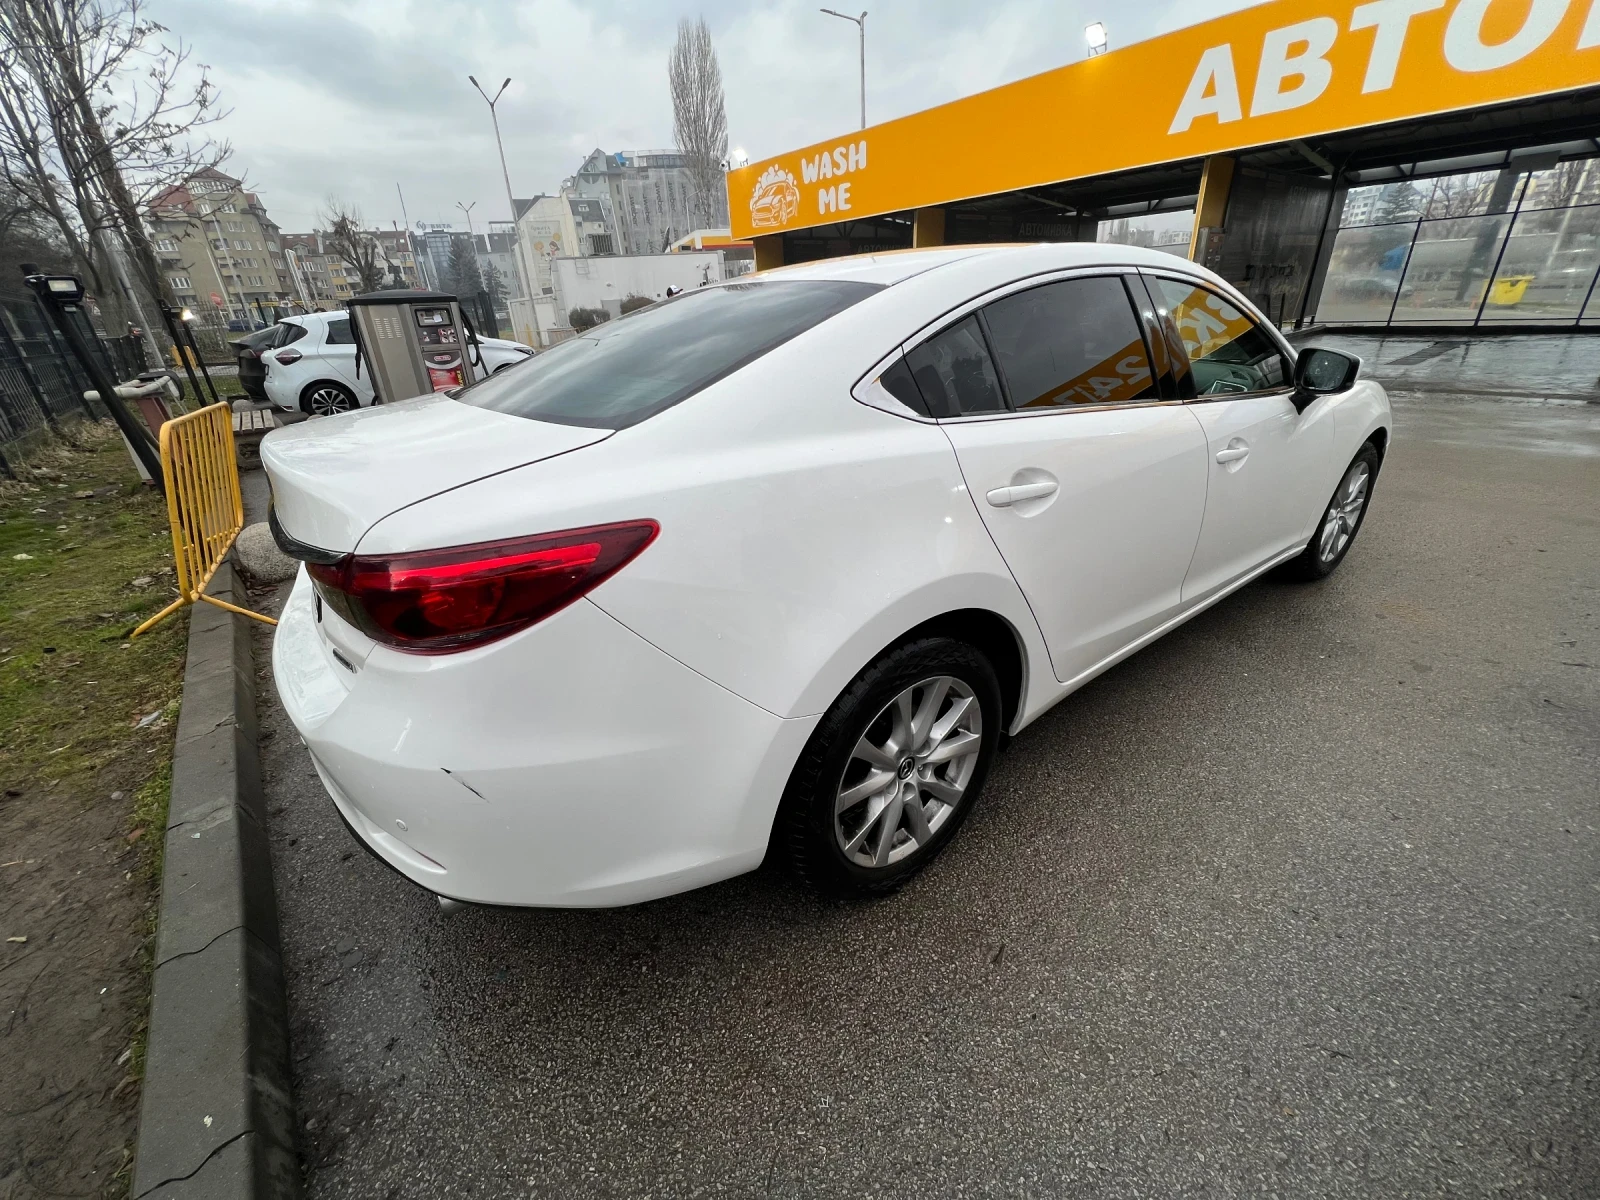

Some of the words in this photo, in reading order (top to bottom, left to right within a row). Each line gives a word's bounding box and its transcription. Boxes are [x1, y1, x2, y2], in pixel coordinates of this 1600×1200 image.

[1167, 0, 1600, 135] АВТО
[801, 140, 867, 184] WASH
[818, 182, 852, 215] ME
[1018, 222, 1073, 237] АВТОМИВКА
